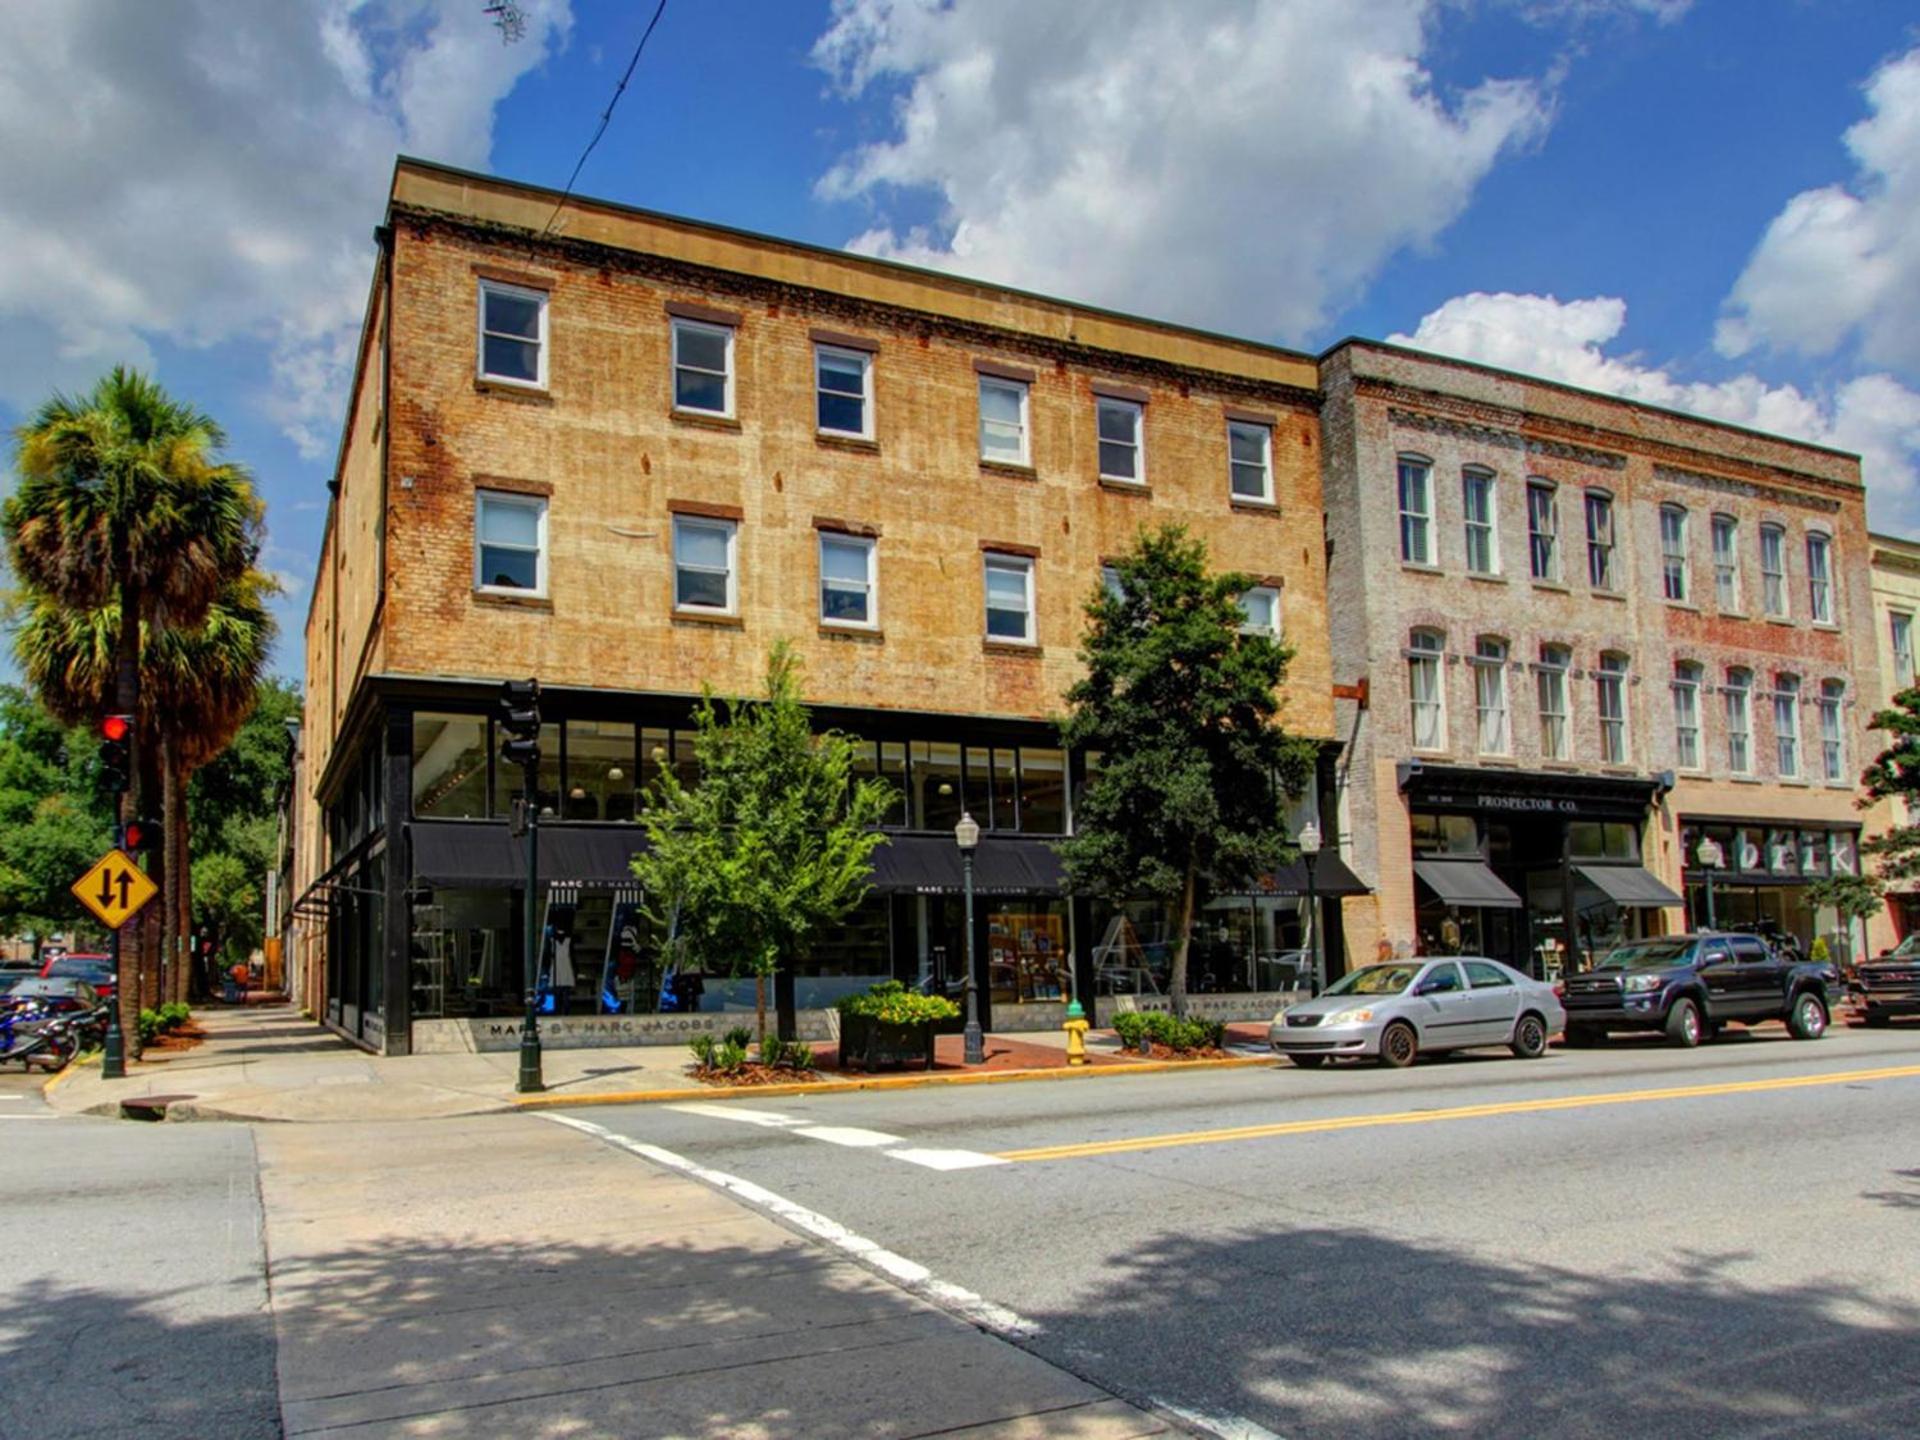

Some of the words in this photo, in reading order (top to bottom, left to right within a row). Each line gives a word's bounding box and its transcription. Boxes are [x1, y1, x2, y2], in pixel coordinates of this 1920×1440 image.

[1478, 795, 1554, 811] PROSPECTOR
[550, 880, 583, 889] MARC
[585, 1021, 633, 1033] MARC
[641, 1019, 716, 1032] JACOBS
